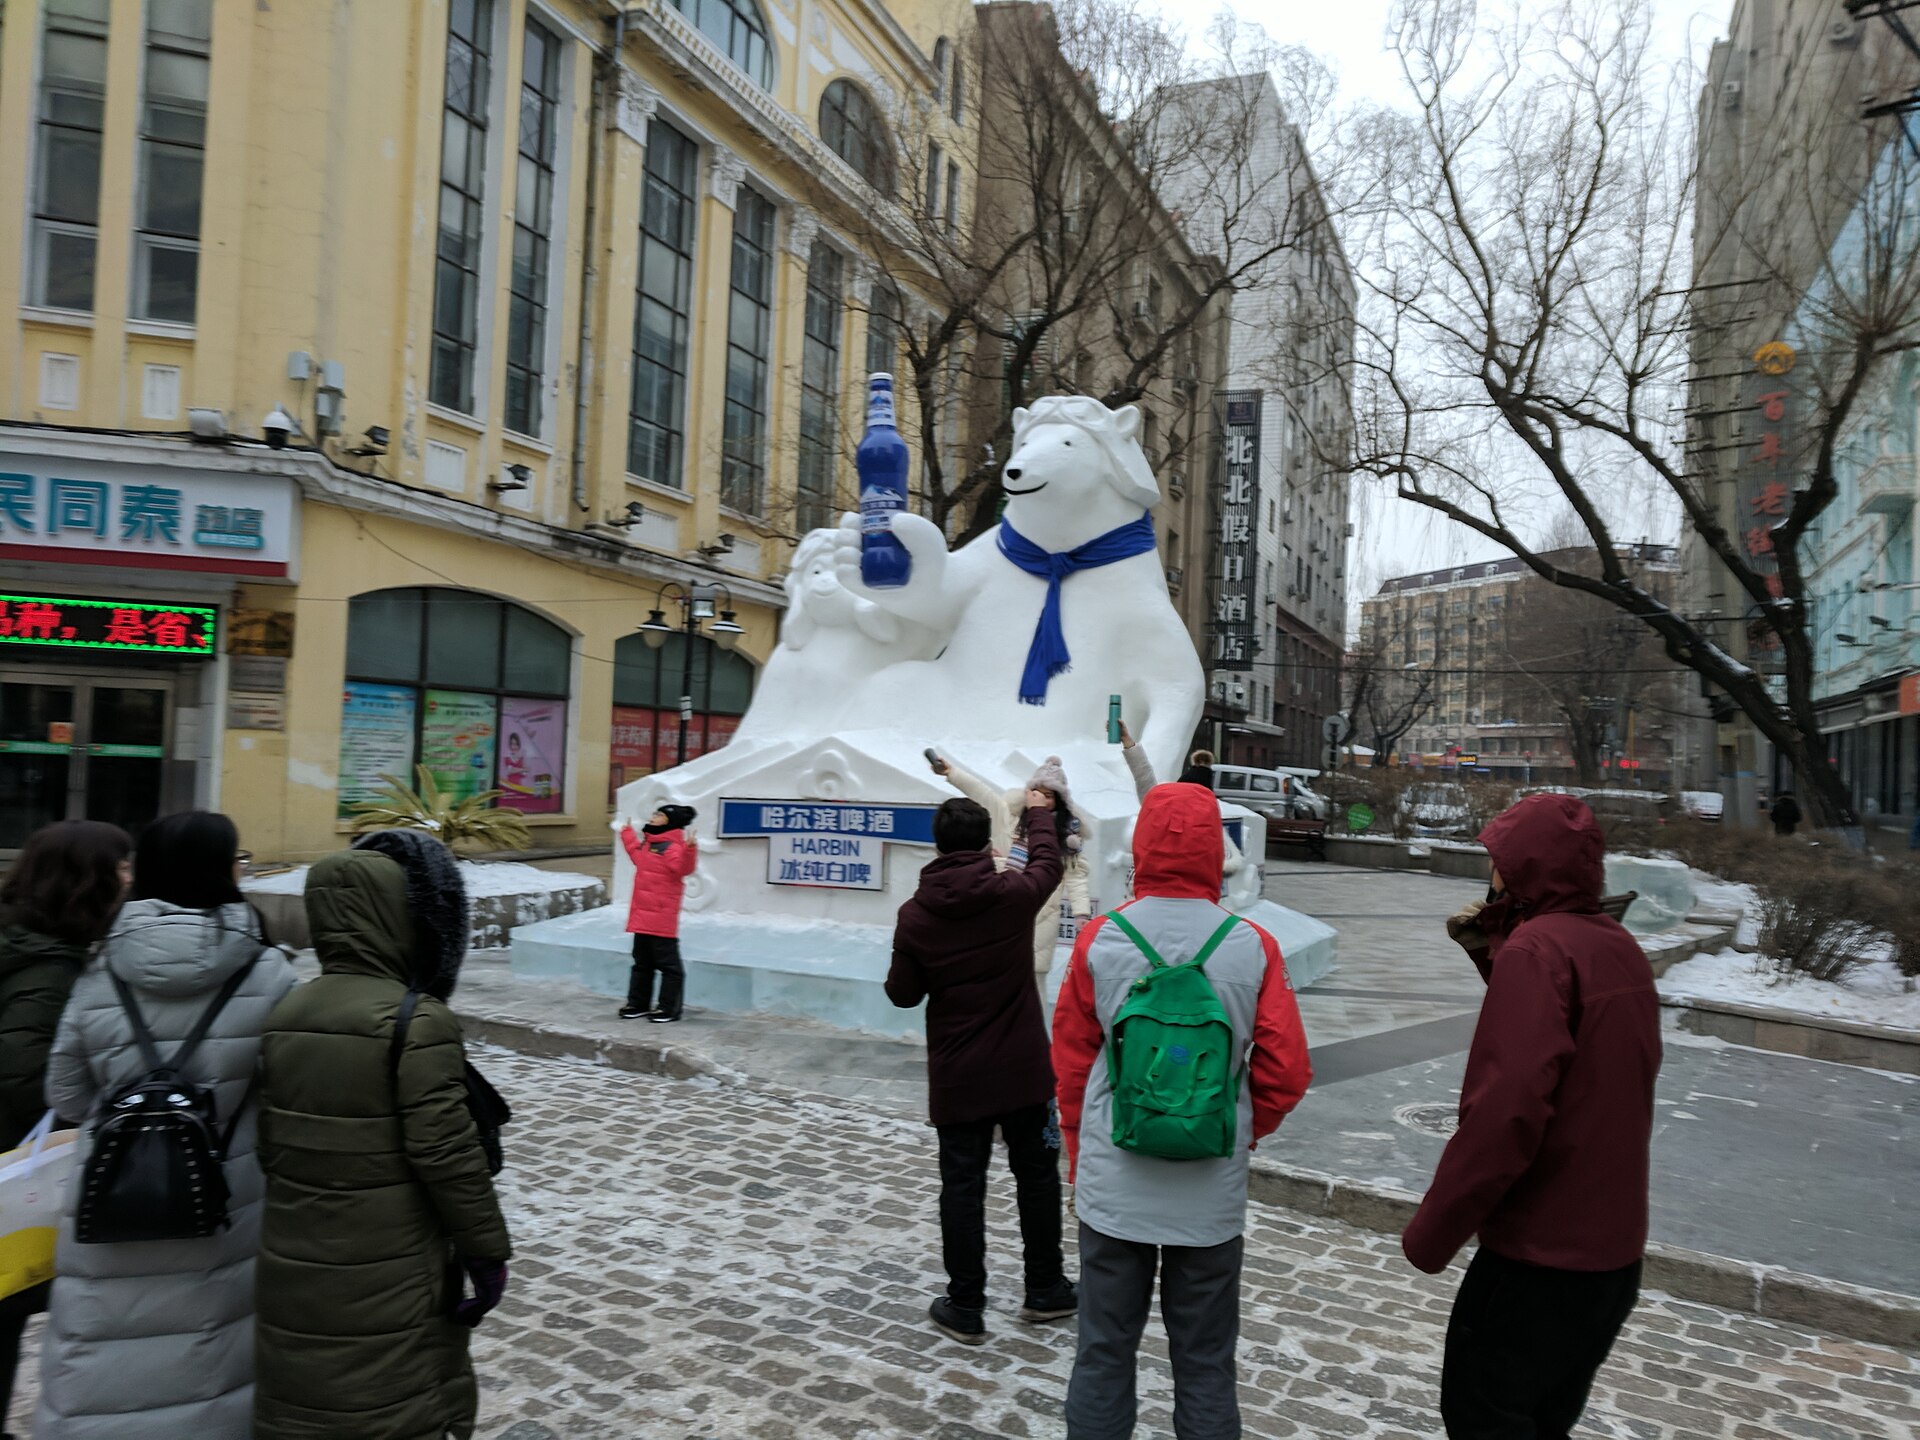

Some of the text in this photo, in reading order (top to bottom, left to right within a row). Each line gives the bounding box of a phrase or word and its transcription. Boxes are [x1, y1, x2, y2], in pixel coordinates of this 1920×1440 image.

[1218, 435, 1254, 661] 北北假日酒店
[760, 805, 895, 833] 哈尔滨啤酒
[792, 838, 860, 857] HARBIN
[779, 858, 872, 885] 冰纯白啤
